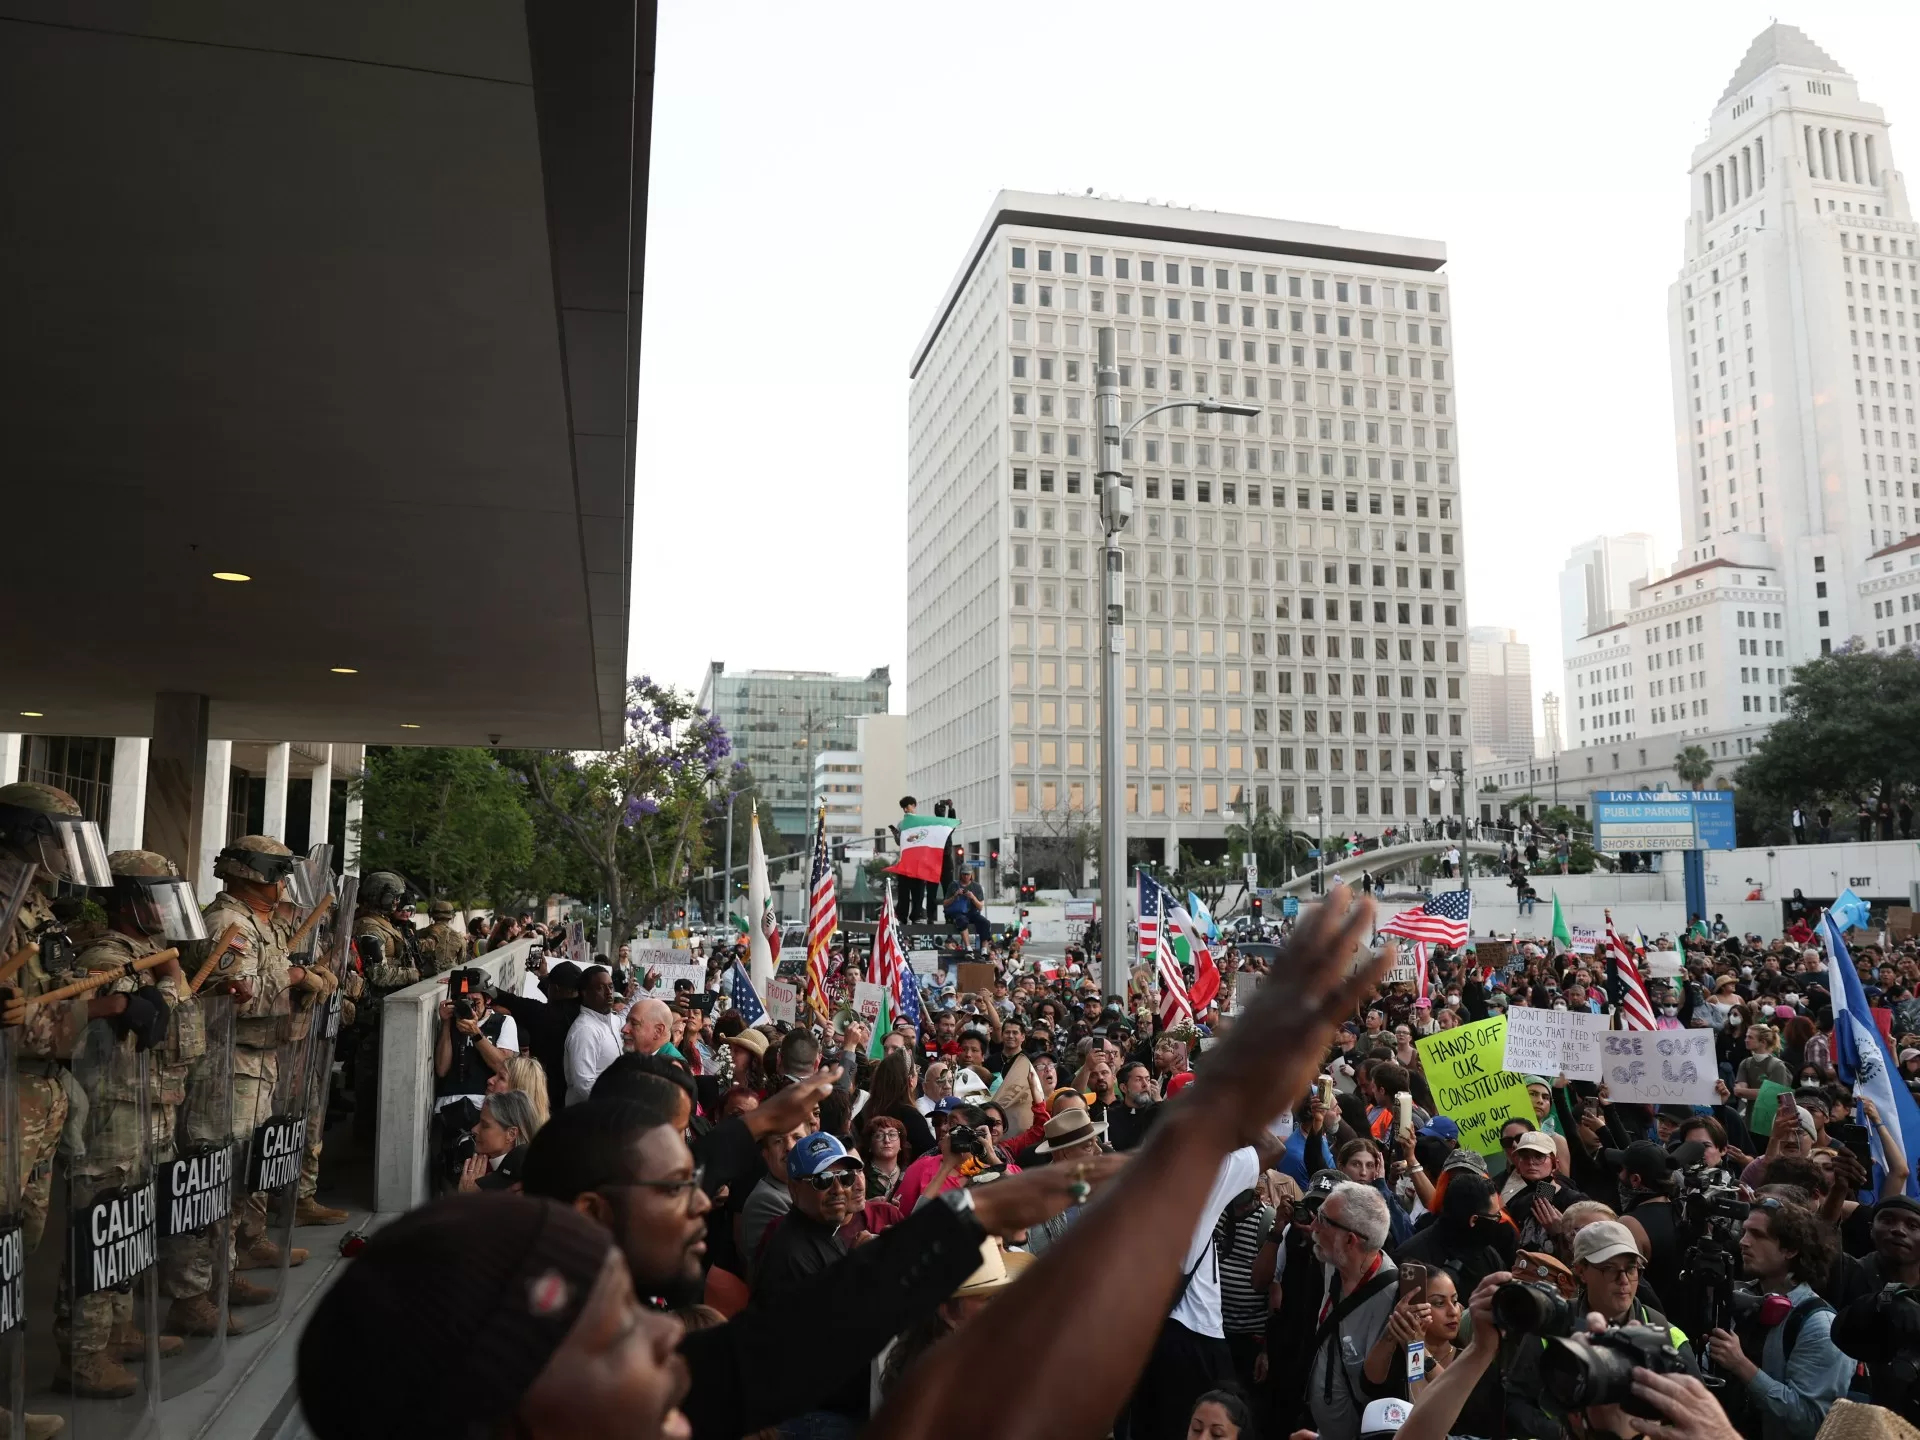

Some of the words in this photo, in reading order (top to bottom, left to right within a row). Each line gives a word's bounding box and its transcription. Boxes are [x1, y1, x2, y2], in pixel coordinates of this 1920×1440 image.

[1610, 792, 1632, 801] LOS
[1691, 791, 1722, 801] MALL
[1604, 807, 1642, 817] PUBLIC
[1644, 807, 1690, 817] PARKING
[1602, 840, 1637, 849] SHOPS
[1637, 840, 1643, 848] &
[1646, 838, 1693, 848] SERVICES
[1849, 876, 1871, 887] EXIT
[1572, 926, 1596, 937] FIGHT
[1511, 1007, 1540, 1021] DONT
[1546, 1011, 1565, 1025] BITE
[1572, 1013, 1586, 1026] THE
[1509, 1022, 1542, 1036] HANDS
[1545, 1026, 1566, 1039] THAT
[1570, 1030, 1588, 1041] FEED
[1427, 1031, 1475, 1064] HANDS
[1477, 1023, 1502, 1046] OFF
[1507, 1034, 1557, 1050] IMMIGRANTS
[1562, 1041, 1575, 1052] ARE
[1579, 1042, 1591, 1052] THE
[1604, 1036, 1643, 1055] ICE
[1656, 1035, 1708, 1056] OUT
[1507, 1047, 1542, 1058] BACKBONE
[1547, 1051, 1557, 1059] OF
[1563, 1051, 1580, 1062] THIS
[1453, 1053, 1484, 1079] OUR
[1612, 1060, 1646, 1085] OF
[1662, 1060, 1698, 1084] LA
[1634, 1084, 1684, 1100] NOW
[1455, 1112, 1486, 1136] TRUMP
[1490, 1104, 1511, 1121] OUT
[1320, 1176, 1331, 1189] LA
